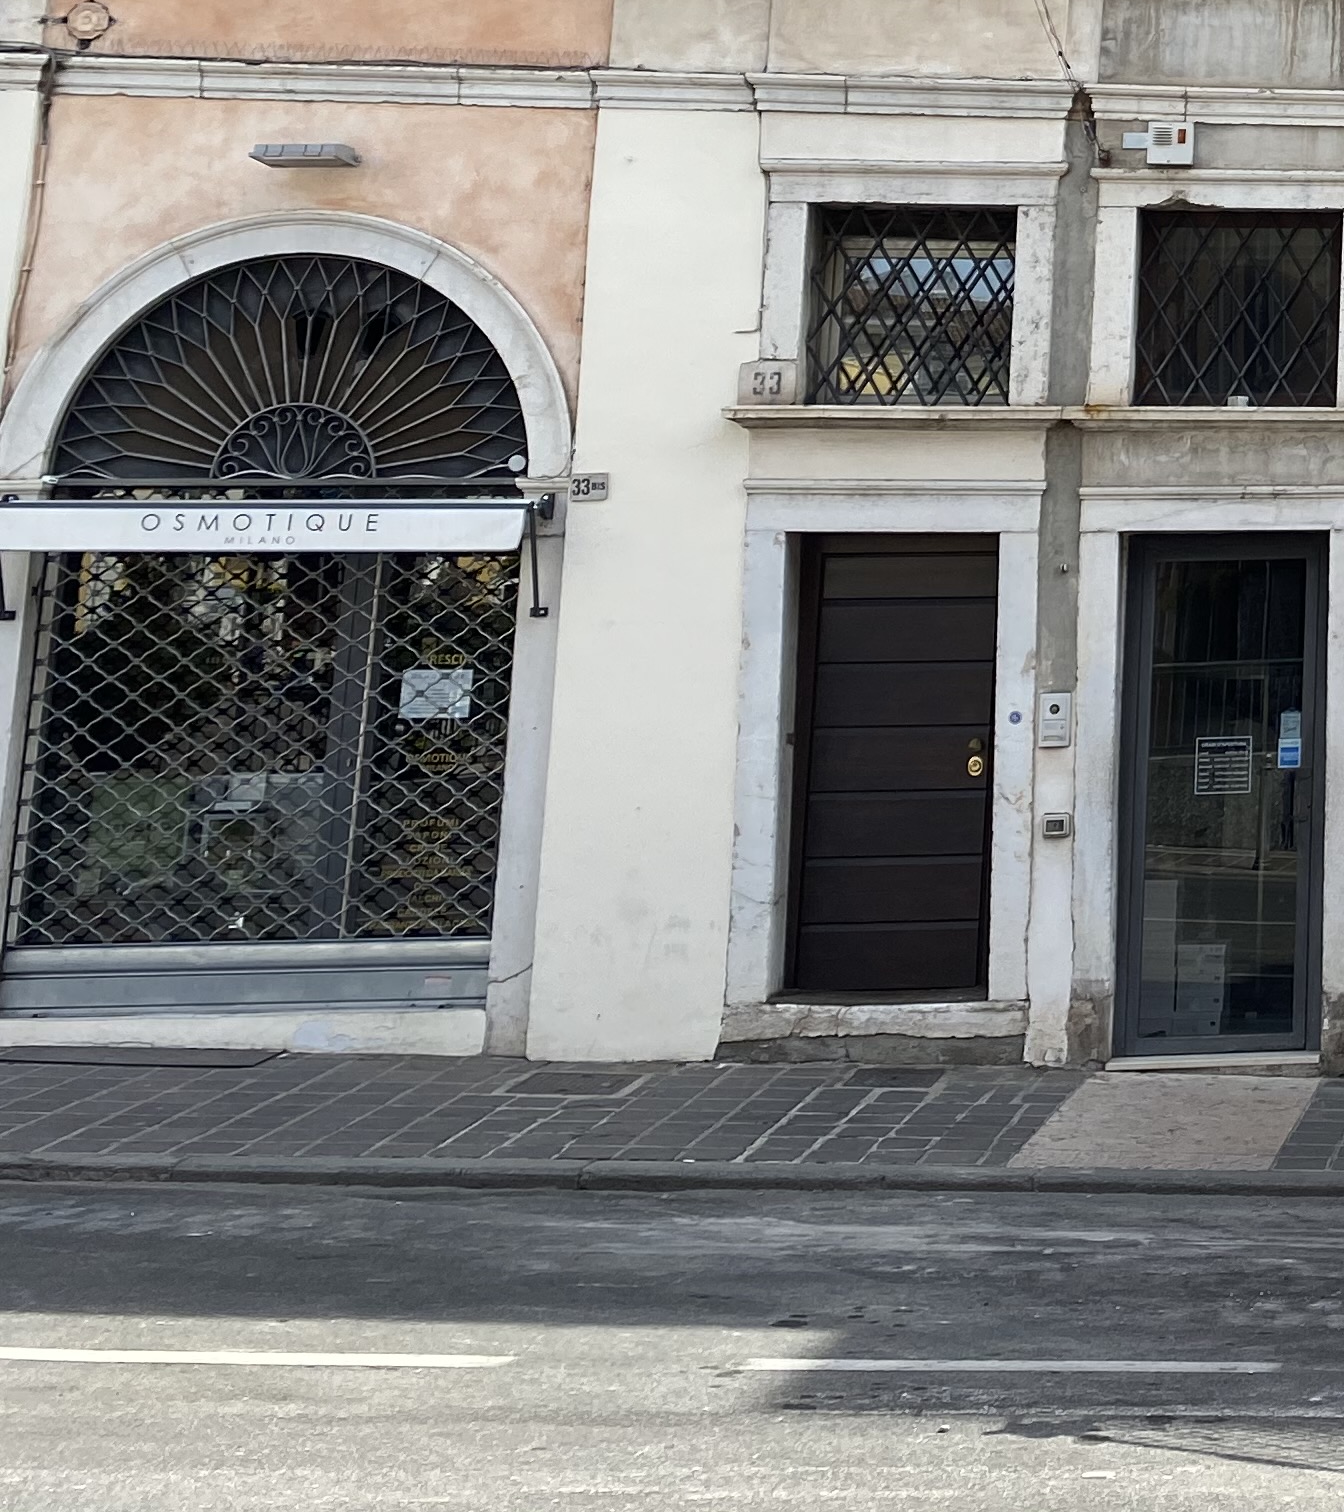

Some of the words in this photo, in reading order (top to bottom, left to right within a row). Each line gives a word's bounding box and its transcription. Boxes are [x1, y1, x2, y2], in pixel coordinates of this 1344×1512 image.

[753, 371, 782, 396] 33
[571, 478, 591, 497] 33
[140, 513, 380, 532] OSMOTIQUE
[223, 535, 296, 545] MILANO
